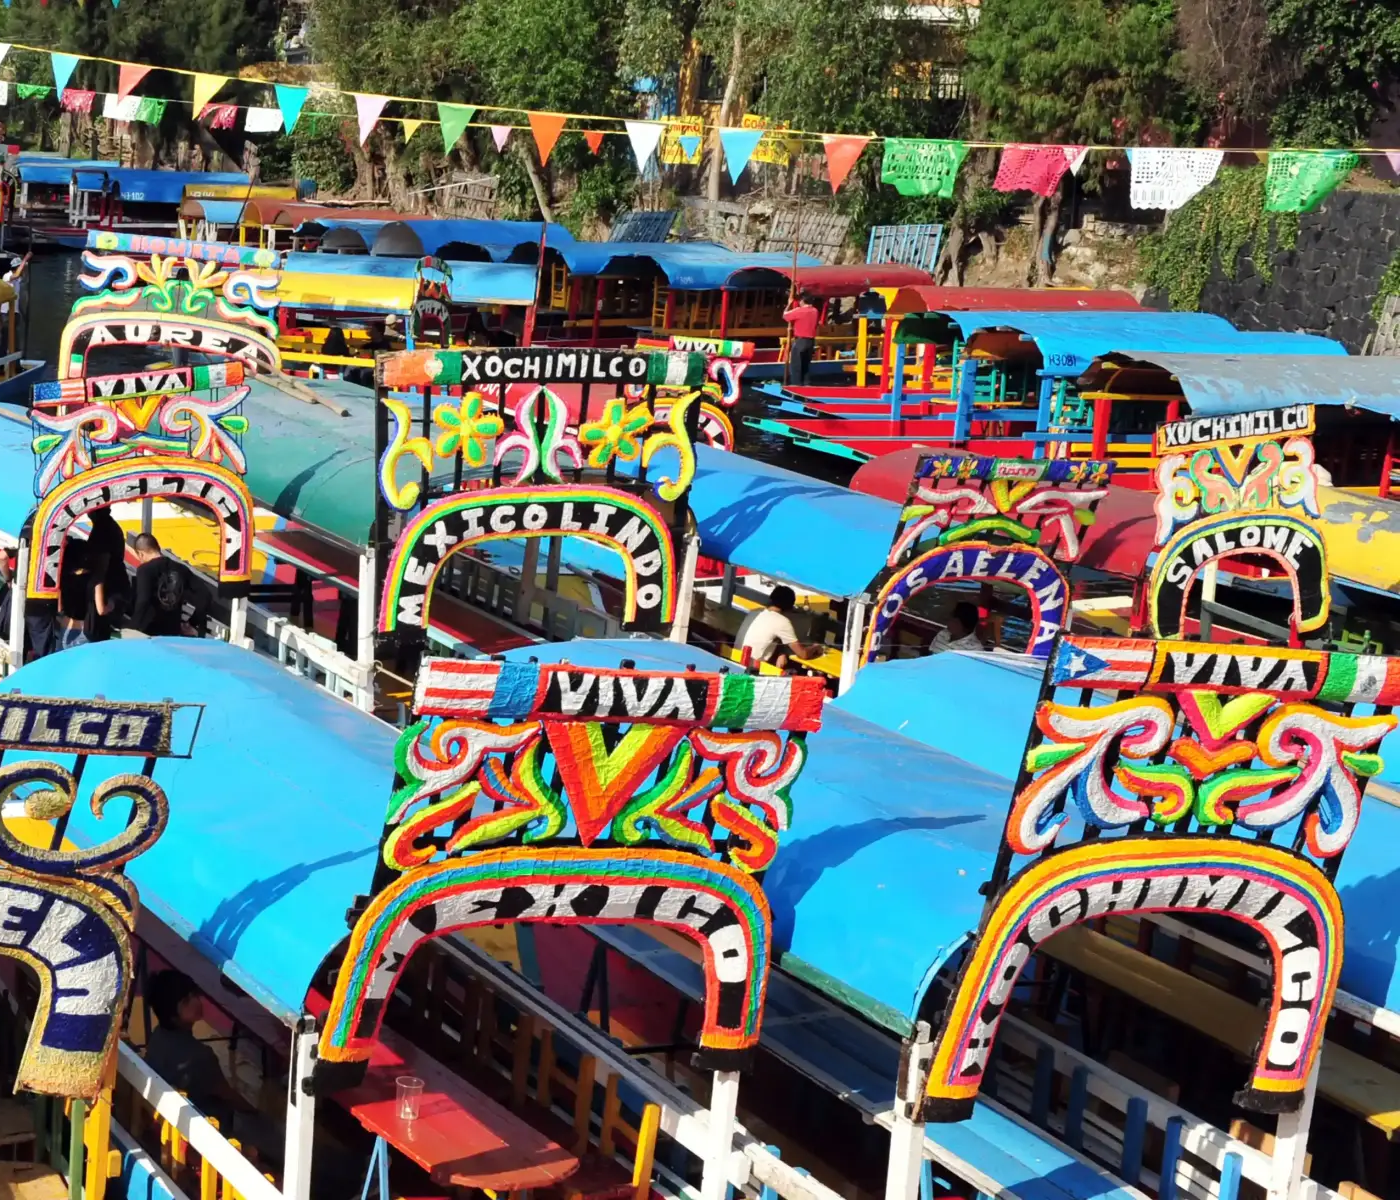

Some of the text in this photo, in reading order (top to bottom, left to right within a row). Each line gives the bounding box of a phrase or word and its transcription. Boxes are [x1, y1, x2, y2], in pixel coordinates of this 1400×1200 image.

[89, 324, 260, 370] AUREA
[461, 353, 647, 381] XOCHIMILCO
[674, 341, 719, 353] VIVA
[94, 372, 186, 397] VIVA
[45, 477, 243, 586] ANGELICA
[397, 501, 663, 627] MEXICO LINDO
[1166, 525, 1314, 590] SALOME
[553, 670, 697, 719] VIVA
[1171, 651, 1311, 692] VIVA
[364, 883, 748, 1000] MEXICO
[962, 873, 1322, 1077] XOCHIMILCO
